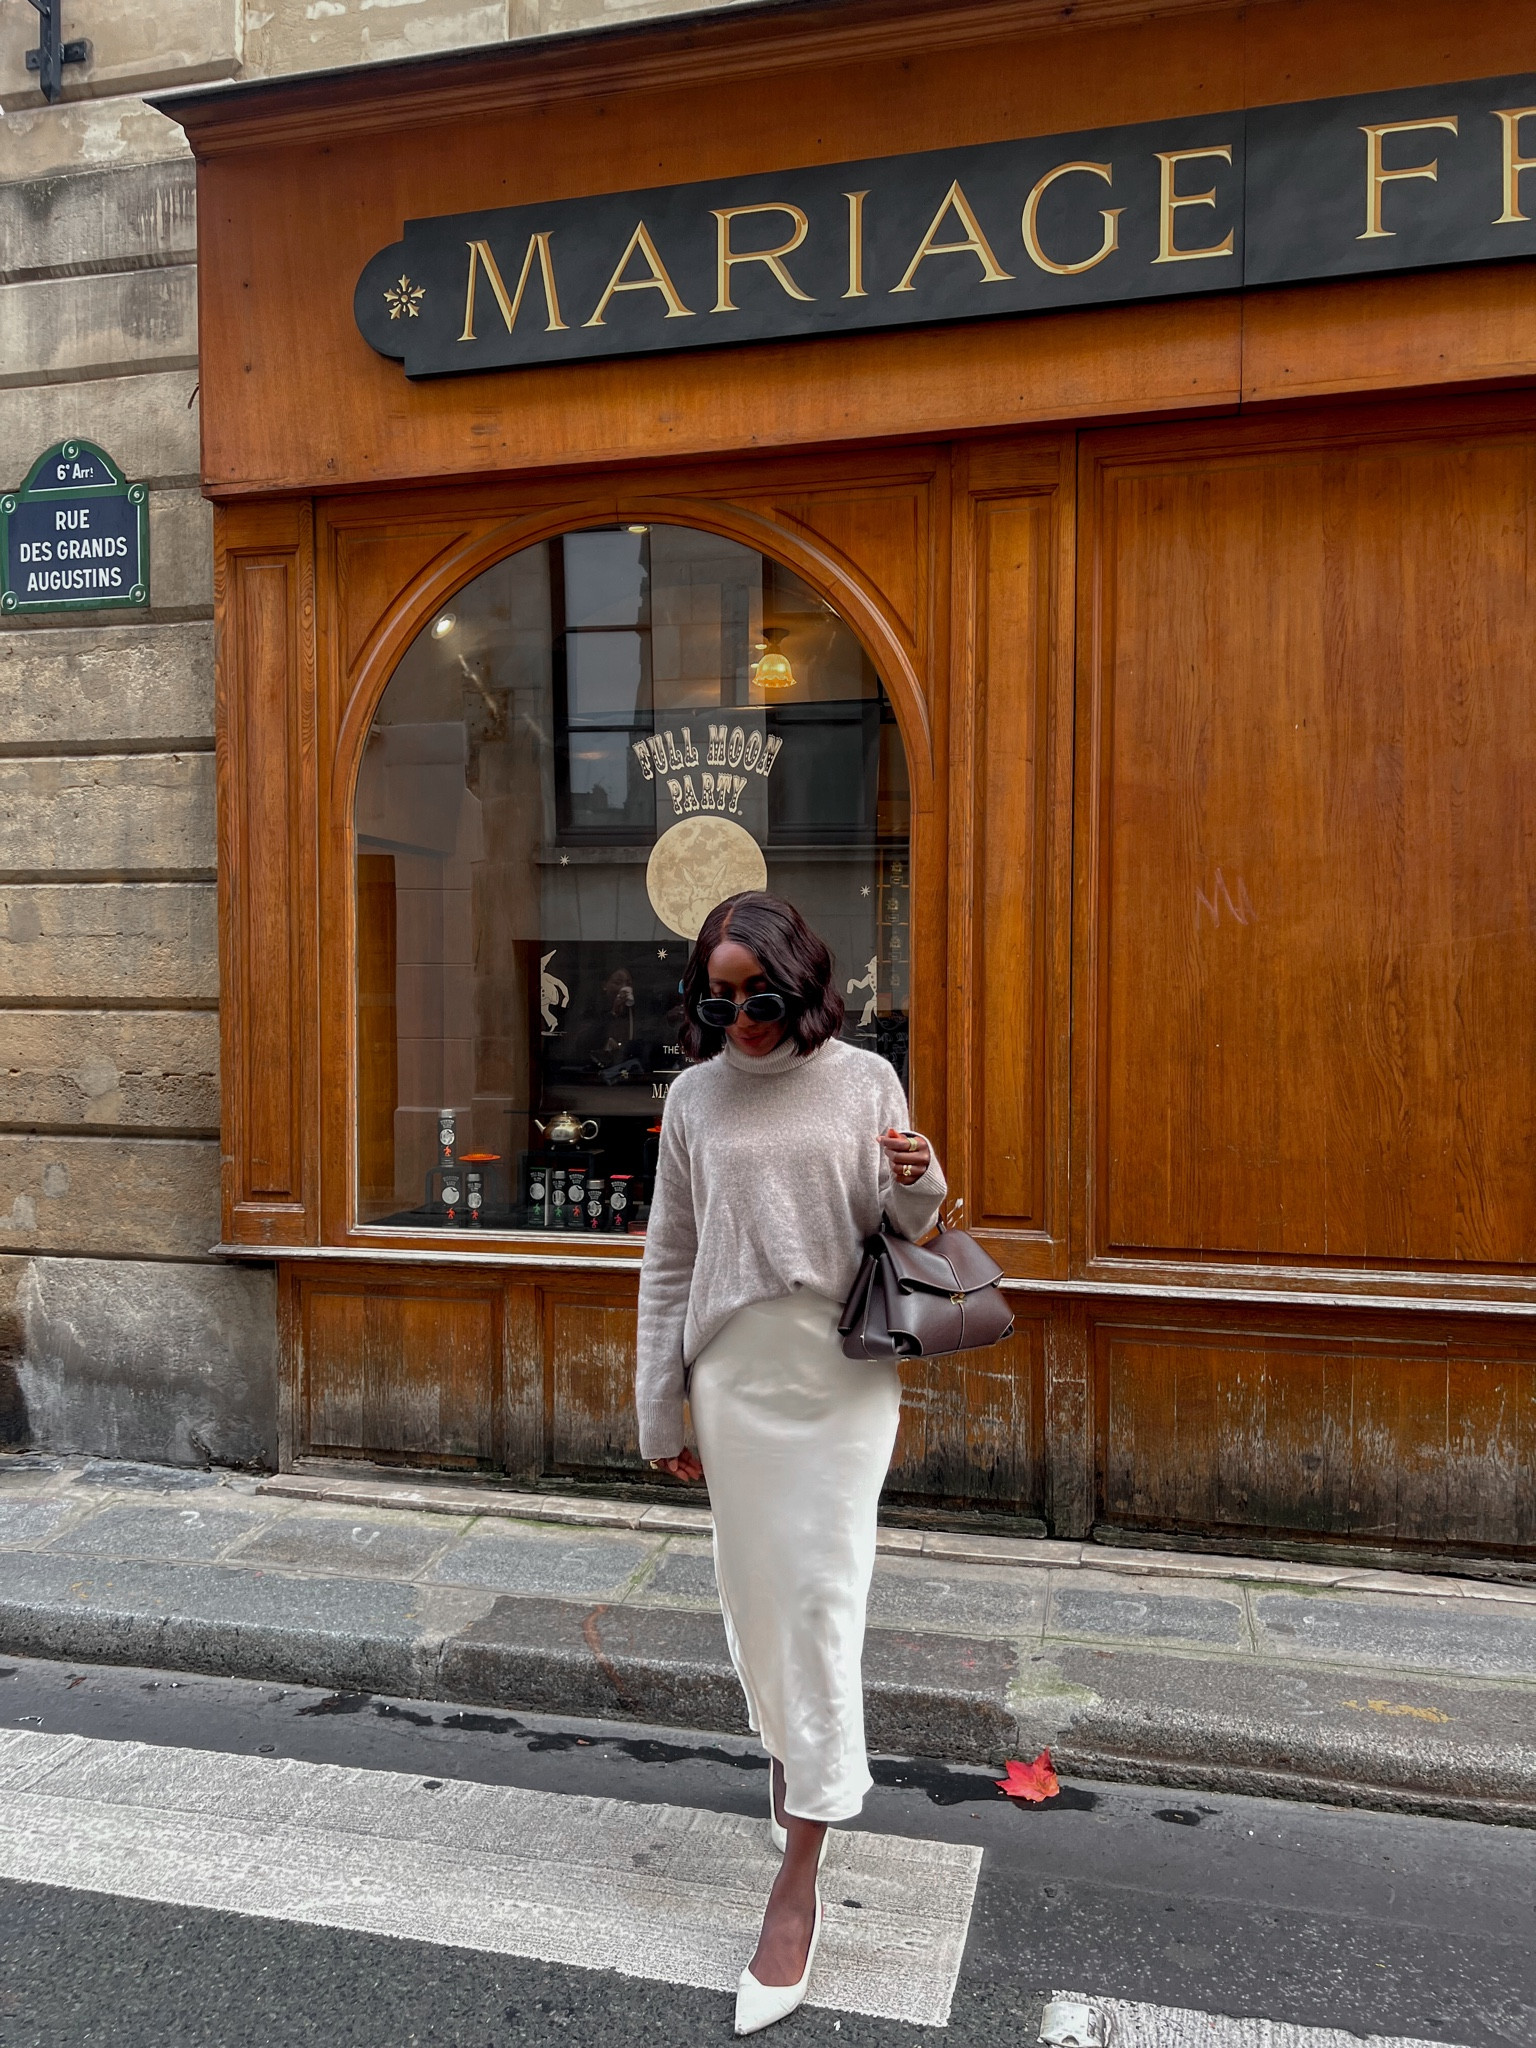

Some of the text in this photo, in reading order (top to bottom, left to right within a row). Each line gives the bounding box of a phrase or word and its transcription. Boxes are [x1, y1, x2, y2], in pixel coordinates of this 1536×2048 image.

[456, 144, 1235, 343] MARIAGE
[55, 509, 90, 530] RUE
[20, 536, 128, 562] DES GRANDS
[27, 567, 123, 592] AUGUSTINS
[632, 724, 783, 780] FULL MOON
